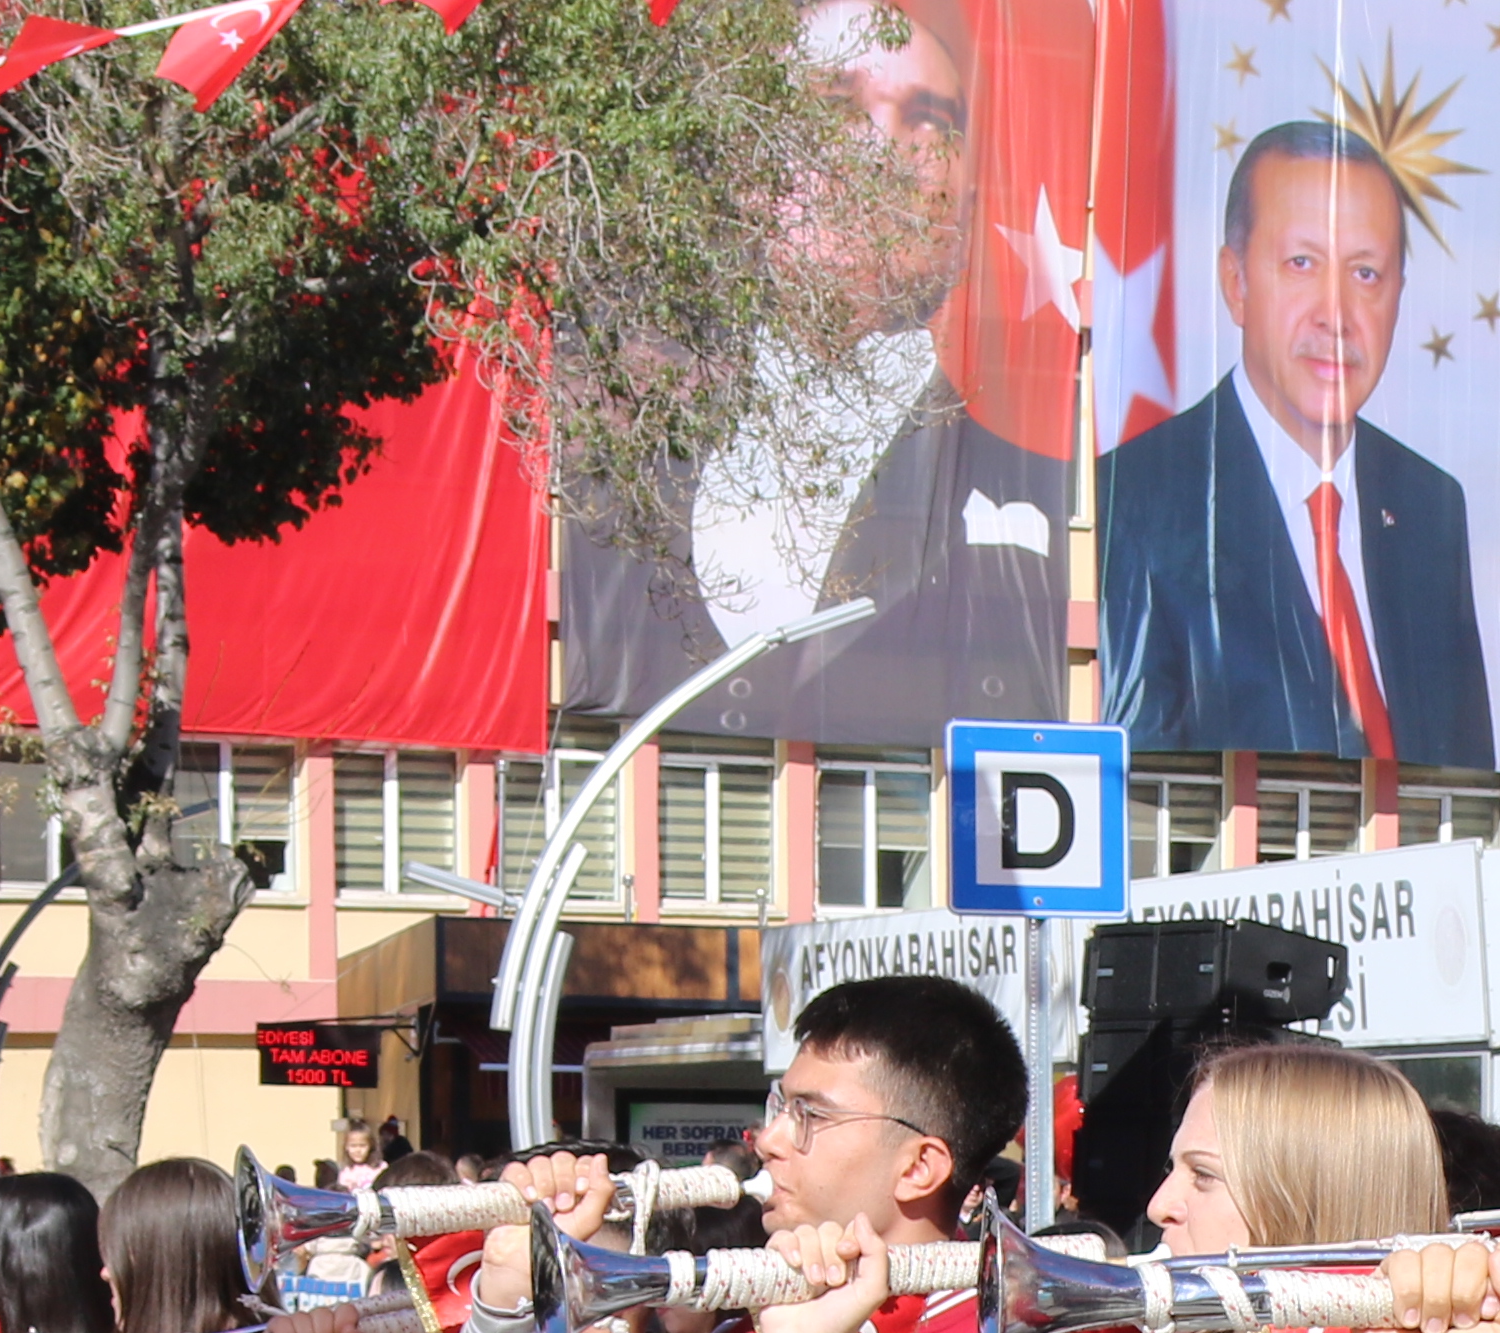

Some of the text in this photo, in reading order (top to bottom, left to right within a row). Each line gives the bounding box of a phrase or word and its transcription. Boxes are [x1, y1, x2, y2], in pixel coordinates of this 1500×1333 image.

[1002, 772, 1075, 869] D
[801, 916, 1017, 990] AFYONKARAHİSAR
[270, 1048, 368, 1066] TAM ABONE
[287, 1069, 353, 1086] 1500 TL
[642, 1126, 677, 1140] HER
[662, 1142, 708, 1156] BERE
